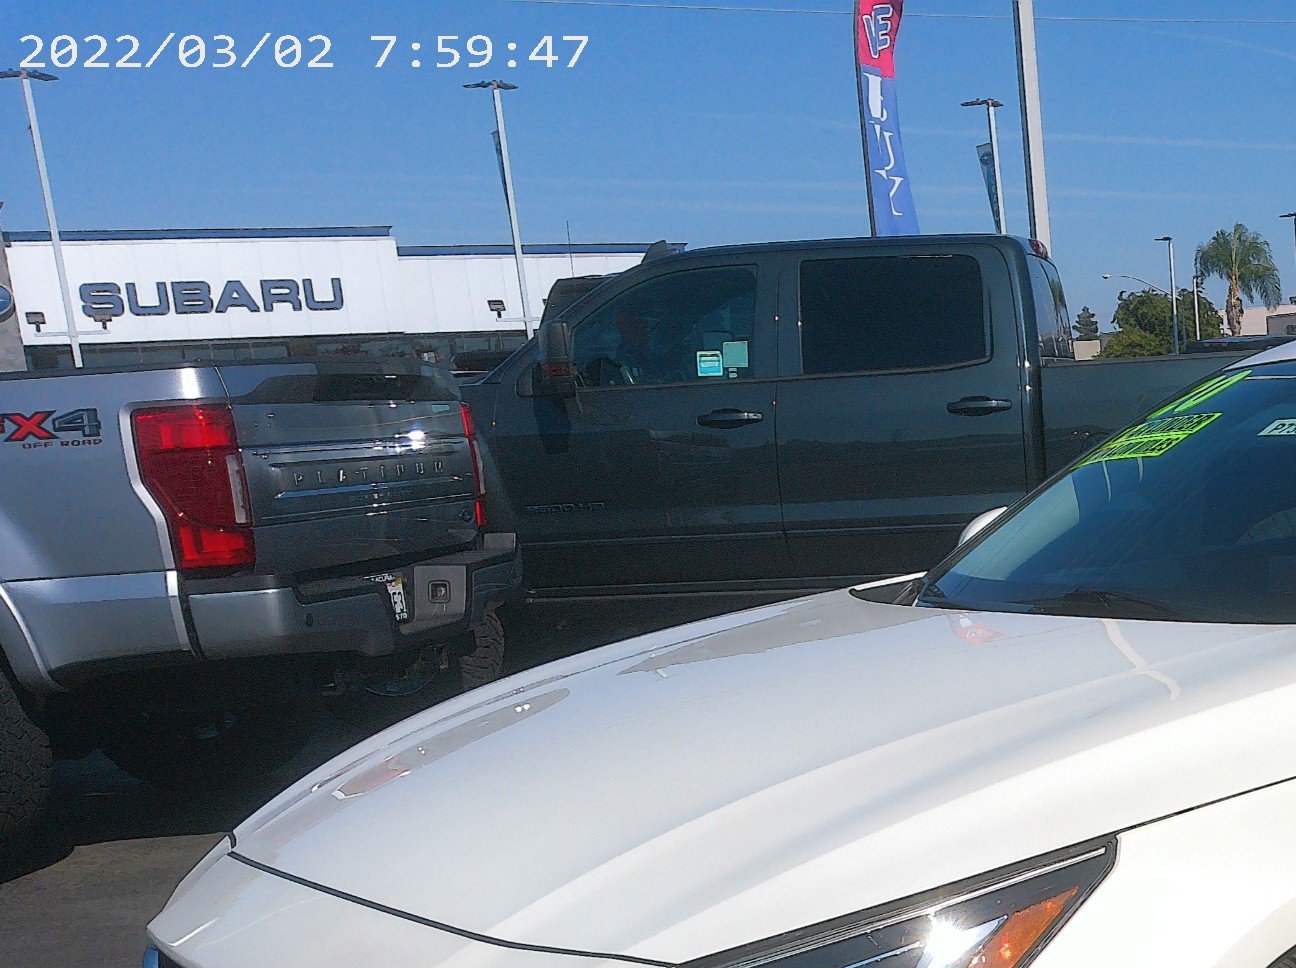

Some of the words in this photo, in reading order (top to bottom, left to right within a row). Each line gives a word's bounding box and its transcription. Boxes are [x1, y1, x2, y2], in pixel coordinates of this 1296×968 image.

[79, 277, 344, 317] SUBARU
[0, 407, 101, 442] X4
[22, 441, 54, 450] OFF
[60, 438, 103, 448] ROAD
